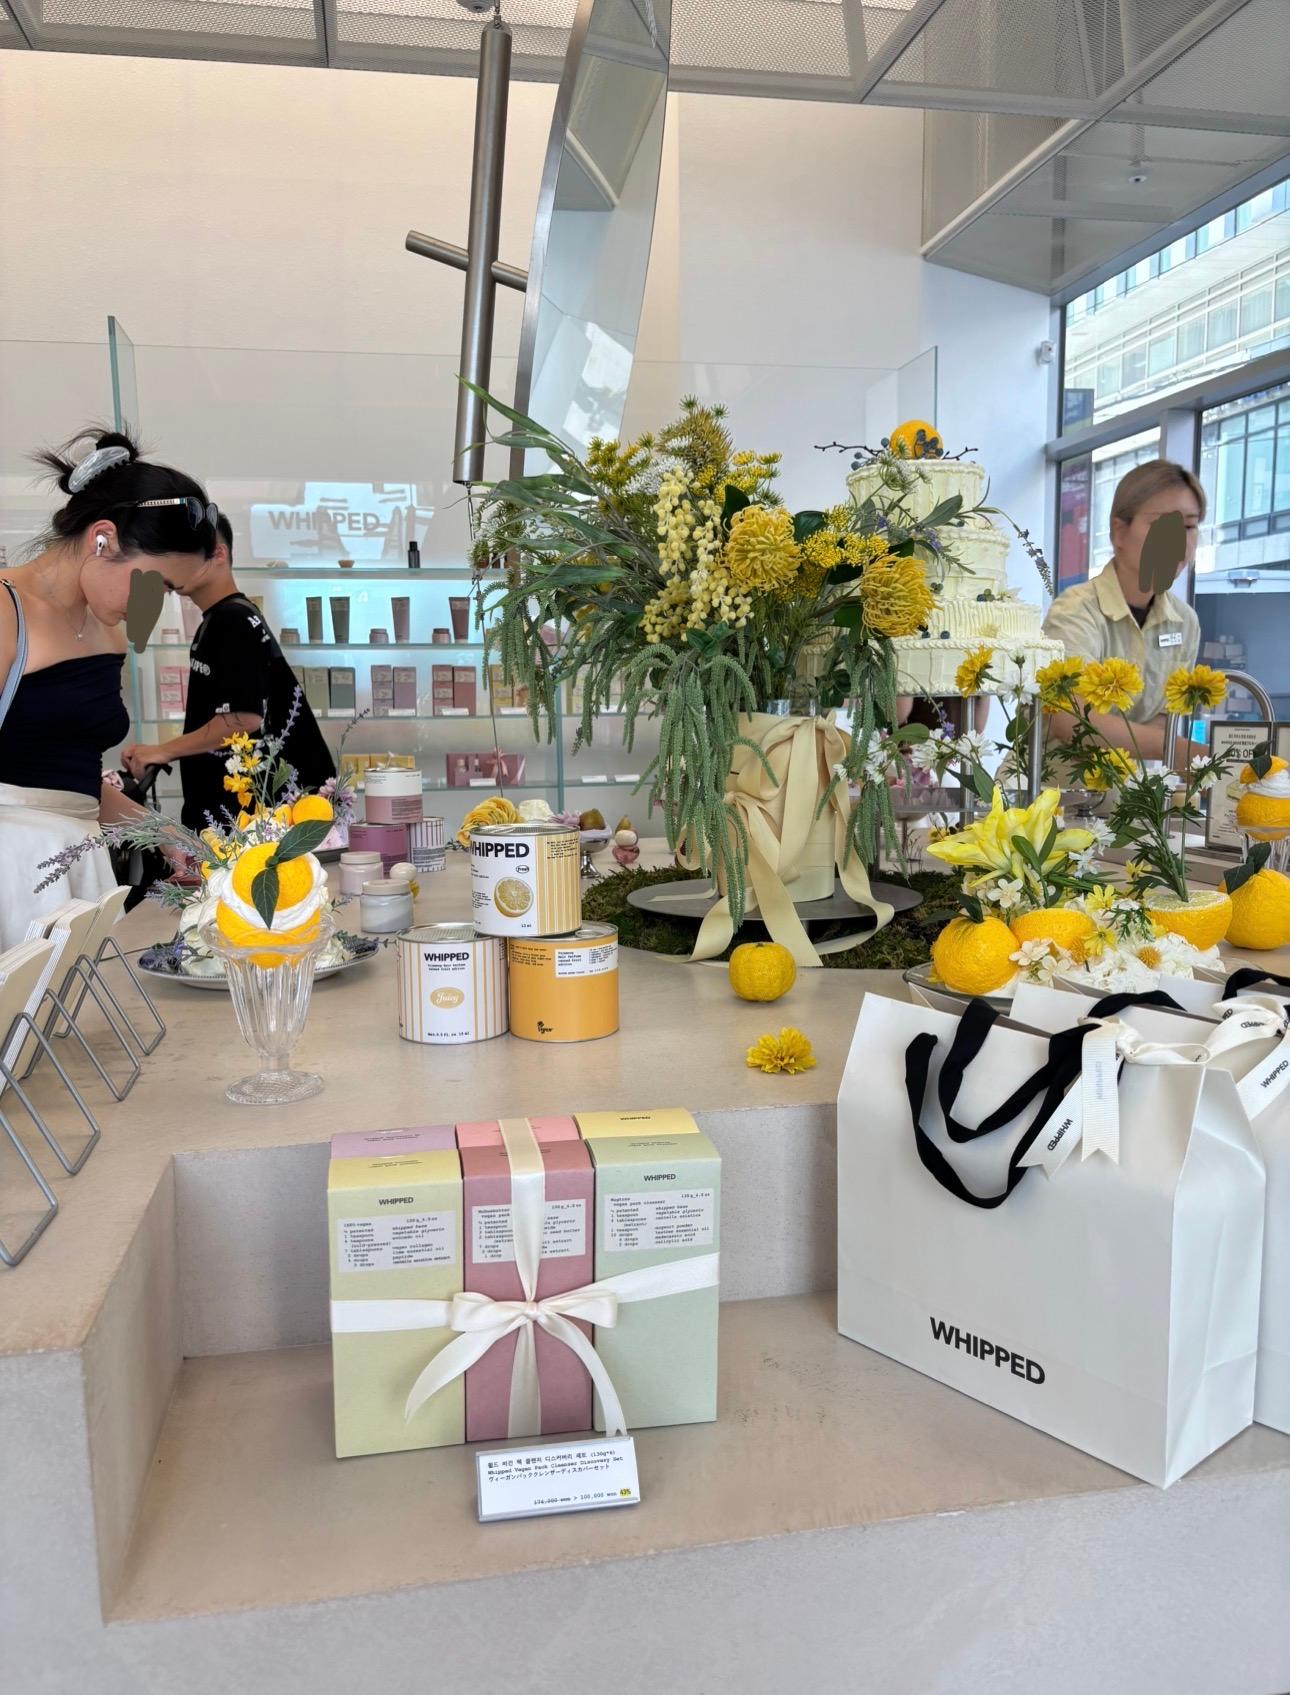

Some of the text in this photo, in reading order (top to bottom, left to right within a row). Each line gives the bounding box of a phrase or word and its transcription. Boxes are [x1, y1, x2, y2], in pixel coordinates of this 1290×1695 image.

[266, 510, 381, 531] WHIPED
[424, 952, 469, 962] WHIPPED
[1260, 1060, 1289, 1088] WHIPPED
[1047, 1118, 1073, 1151] WHIPPED
[379, 1196, 414, 1205] WHIPPED
[929, 1316, 1046, 1385] WHIPPED
